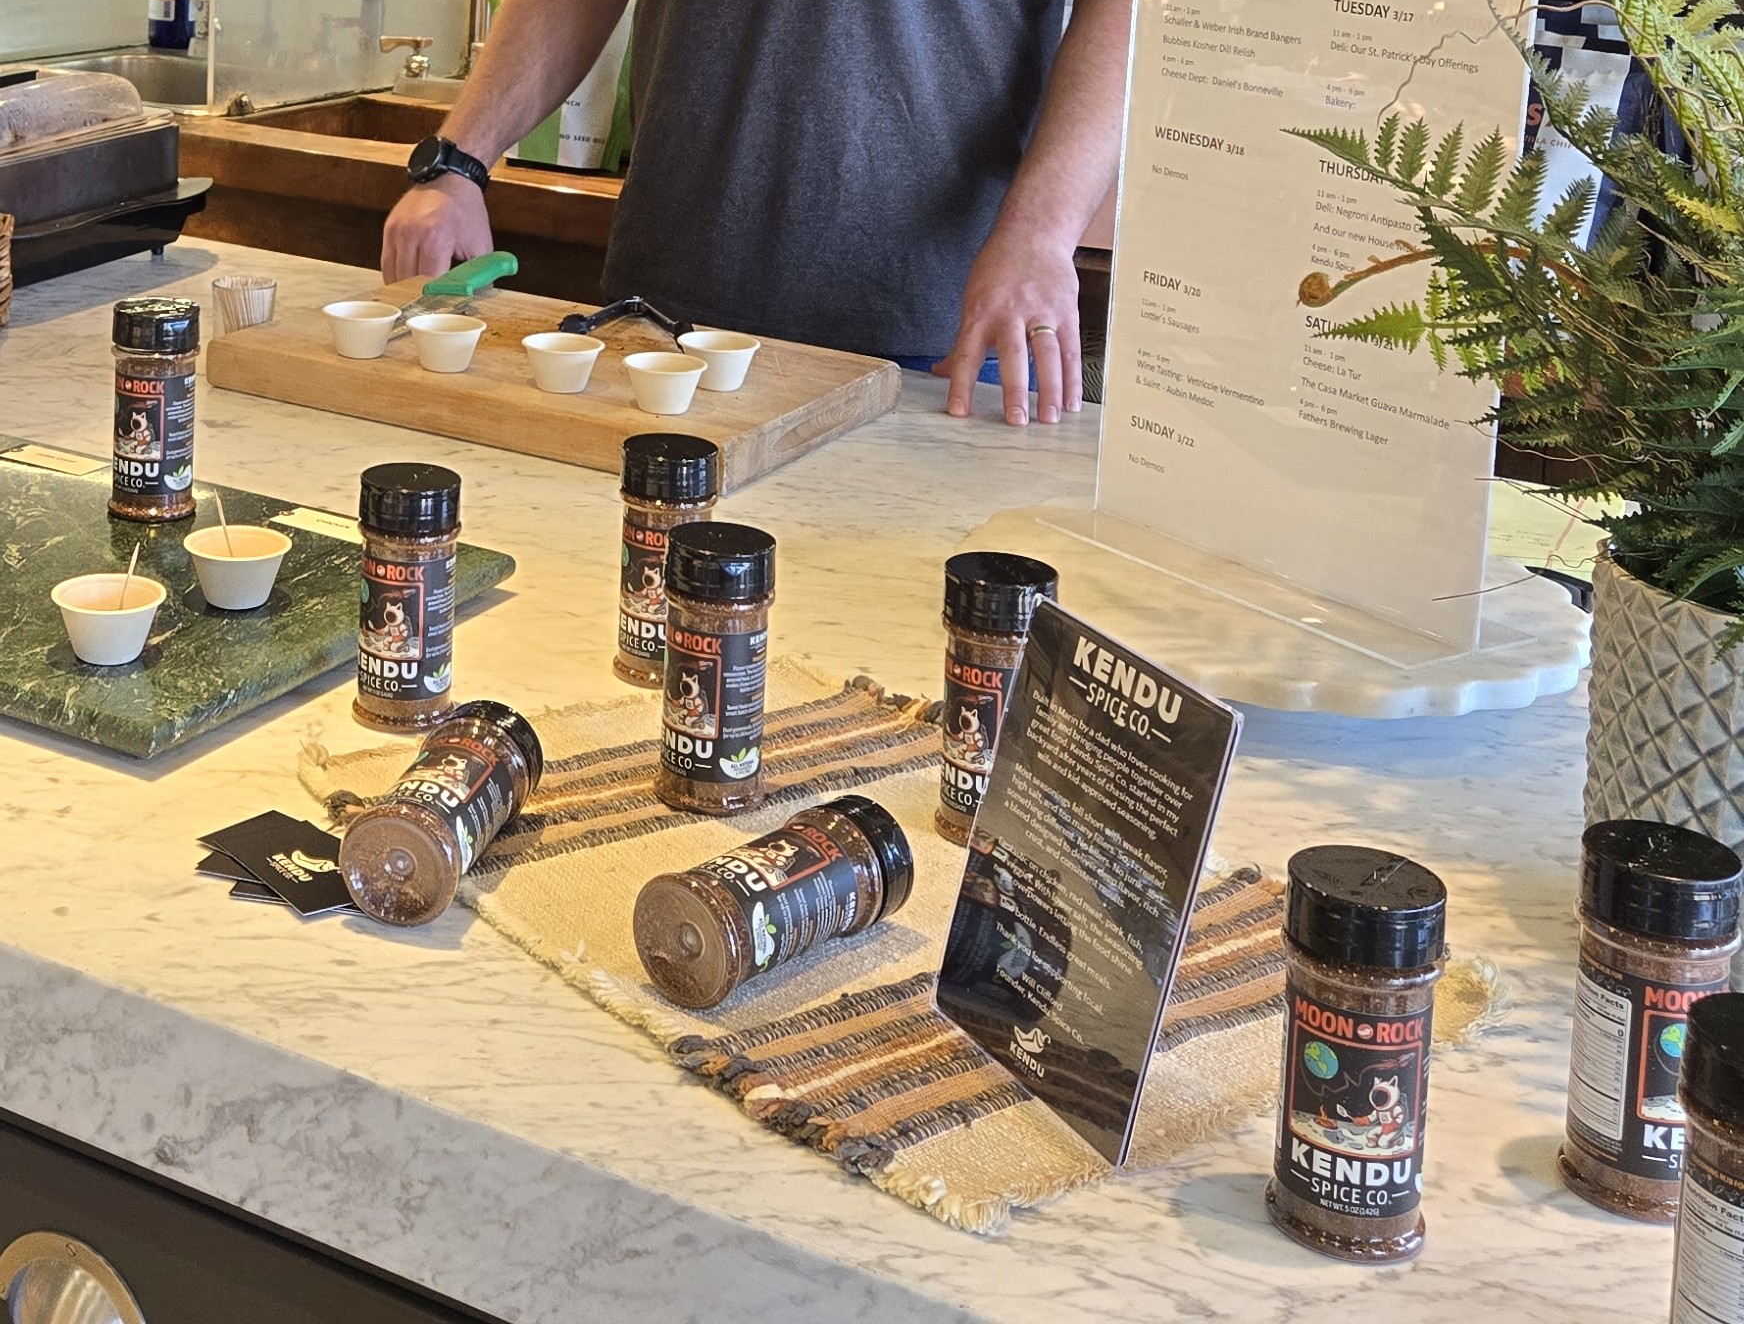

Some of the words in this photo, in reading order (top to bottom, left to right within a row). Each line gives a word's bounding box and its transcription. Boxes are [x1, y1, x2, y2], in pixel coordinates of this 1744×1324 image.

[1163, 14, 1192, 28] Schaller
[1201, 20, 1226, 33] Weber
[1227, 24, 1245, 36] Irish
[1246, 27, 1268, 40] Brand
[1270, 31, 1302, 46] Bangers
[1392, 10, 1413, 23] 3/17
[1162, 34, 1191, 47] Bubbies
[1193, 39, 1217, 52] Kosher
[1233, 45, 1255, 58] Relish
[1330, 41, 1350, 53] Deli:
[1350, 44, 1366, 55] Our
[1381, 48, 1417, 64] Patrick's
[1438, 56, 1479, 75] Offerings
[1160, 67, 1187, 80] Cheese
[1211, 76, 1242, 90] Daniel's
[1243, 82, 1283, 98] Bonneville
[1325, 95, 1356, 111] Bakery:
[1154, 125, 1224, 151] WEDNESDAY
[1225, 143, 1244, 157] 3/18
[1152, 164, 1162, 175] No
[1163, 166, 1189, 181] Demos
[1315, 201, 1335, 214] Deli:
[1336, 205, 1369, 223] Negroni
[1370, 213, 1411, 232] Antipasto
[1313, 221, 1330, 235] And
[1368, 234, 1394, 250] House
[1310, 255, 1334, 268] Kendu
[1143, 270, 1181, 291] FRIDAY
[1183, 284, 1201, 298] 3/20
[1167, 316, 1199, 335] Sausages
[1302, 355, 1334, 373] Cheese:
[133, 380, 165, 394] ROCK
[1136, 359, 1155, 372] Wine
[1219, 384, 1264, 407] Vermentino
[1189, 392, 1214, 408] Medoc
[1301, 376, 1315, 389] The
[1317, 381, 1337, 396] Casa
[1339, 387, 1369, 406] Market
[1370, 396, 1397, 414] Guava
[1399, 405, 1450, 430] Marmalade
[1130, 414, 1174, 440] SUNDAY
[1176, 432, 1194, 449] 3/22
[1298, 409, 1327, 427] Fathers
[1329, 418, 1364, 440] Brewing
[1365, 430, 1388, 448] Lager
[386, 564, 425, 581] ROCK
[683, 635, 723, 654] ROCK
[962, 666, 1003, 689] ROCK
[1073, 636, 1183, 724] KENDU
[1086, 683, 1128, 721] SPICE
[1129, 710, 1151, 740] CO.
[460, 737, 500, 767] ROCK
[1030, 718, 1050, 738] great
[1050, 729, 1070, 748] food.
[1069, 742, 1094, 765] Kendu
[1093, 759, 1115, 780] Spice
[1128, 781, 1157, 807] started
[1034, 704, 1058, 727] family
[1071, 729, 1104, 758] bringing
[1102, 749, 1130, 776] people
[1129, 767, 1164, 800] together
[1163, 792, 1182, 811] over
[1057, 706, 1079, 726] Marin
[1078, 719, 1089, 734] by
[1094, 730, 1110, 746] dad
[1110, 739, 1128, 758] who
[1127, 751, 1149, 772] loves
[1148, 765, 1181, 796] cooking
[1180, 786, 1194, 802] for
[1026, 726, 1059, 757] backyard
[1058, 748, 1076, 767] after
[1075, 763, 1096, 783] years
[1104, 780, 1135, 810] chasing
[1135, 800, 1150, 817] the
[1148, 810, 1178, 839] perfect
[1052, 759, 1068, 777] and
[1066, 769, 1117, 812] kid-approved
[1006, 784, 1044, 821] something
[803, 827, 844, 862] ROCK
[1009, 800, 1030, 823] blend
[1029, 815, 1063, 849] designed
[1117, 880, 1143, 907] flavor,
[1142, 899, 1160, 918] rich
[1071, 817, 1093, 841] many
[1134, 860, 1165, 891] created
[1083, 809, 1104, 831] short
[1143, 852, 1169, 880] flavor,
[1059, 852, 1098, 889] consistent
[1012, 876, 1053, 917] overpowers
[1092, 937, 1111, 959] food
[1110, 952, 1135, 978] shine.
[1014, 906, 1038, 932] bottle.
[1038, 925, 1067, 956] Endless
[1065, 947, 1087, 973] great
[1082, 900, 1104, 924] meat,
[1104, 915, 1127, 942] pork,
[1126, 932, 1145, 954] fish,
[1103, 930, 1144, 971] seasoning
[995, 920, 1017, 947] Thank
[1082, 991, 1105, 1018] local.
[995, 963, 1027, 998] Founder,
[1027, 989, 1051, 1017] Kendu
[1050, 1009, 1071, 1035] Spice
[1020, 969, 1036, 989] Will
[1035, 981, 1063, 1013] Clifford
[1600, 993, 1625, 1010] Facts
[1294, 995, 1354, 1040] MOON
[1376, 1016, 1425, 1044] ROCK
[1010, 1040, 1045, 1078] KENDU
[1290, 1136, 1412, 1188] KENDU
[1310, 1177, 1361, 1204] SPICE
[1320, 1198, 1333, 1209] NET
[1350, 1204, 1359, 1214] OZ
